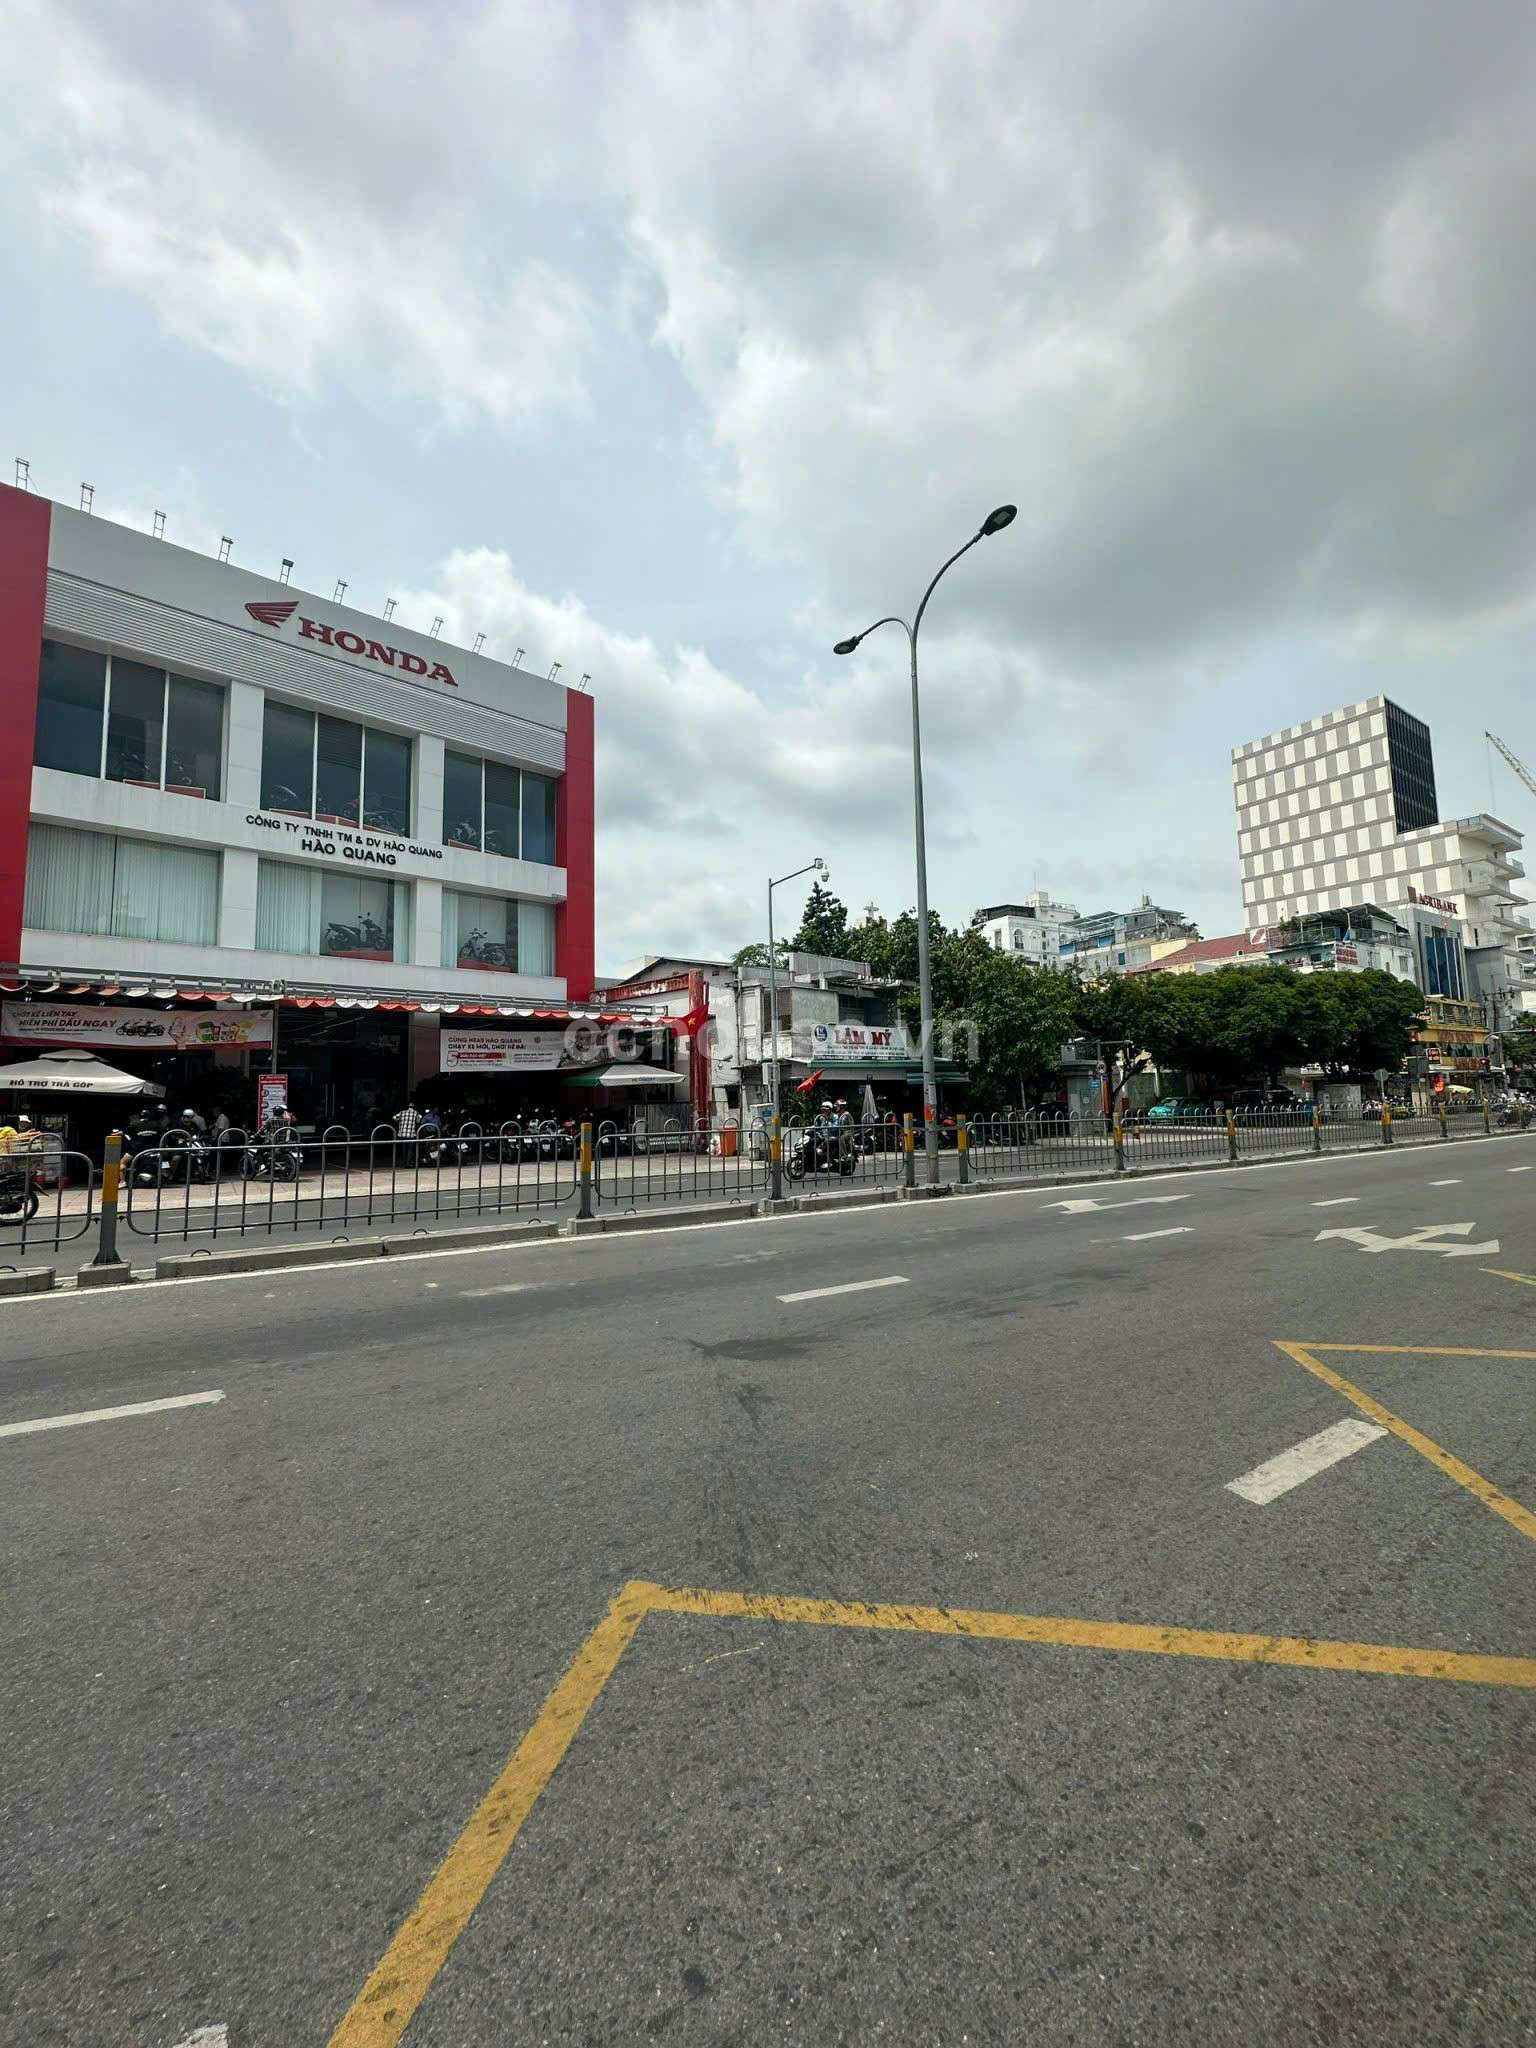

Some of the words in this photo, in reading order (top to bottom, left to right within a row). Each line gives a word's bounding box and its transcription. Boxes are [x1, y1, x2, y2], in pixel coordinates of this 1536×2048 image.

[298, 616, 458, 687] HONDA
[246, 814, 281, 829] CÔNG
[284, 822, 299, 832] TY
[304, 826, 333, 839] TNHH
[337, 832, 352, 843] TM
[355, 835, 363, 844] &
[366, 837, 381, 848] DV
[384, 839, 405, 852] HÀO
[408, 845, 443, 859] QUANG
[301, 838, 336, 855] HÀO
[343, 846, 397, 866] QUANG
[1418, 892, 1458, 914] AGRIBANK
[82, 1019, 117, 1028] NGAY
